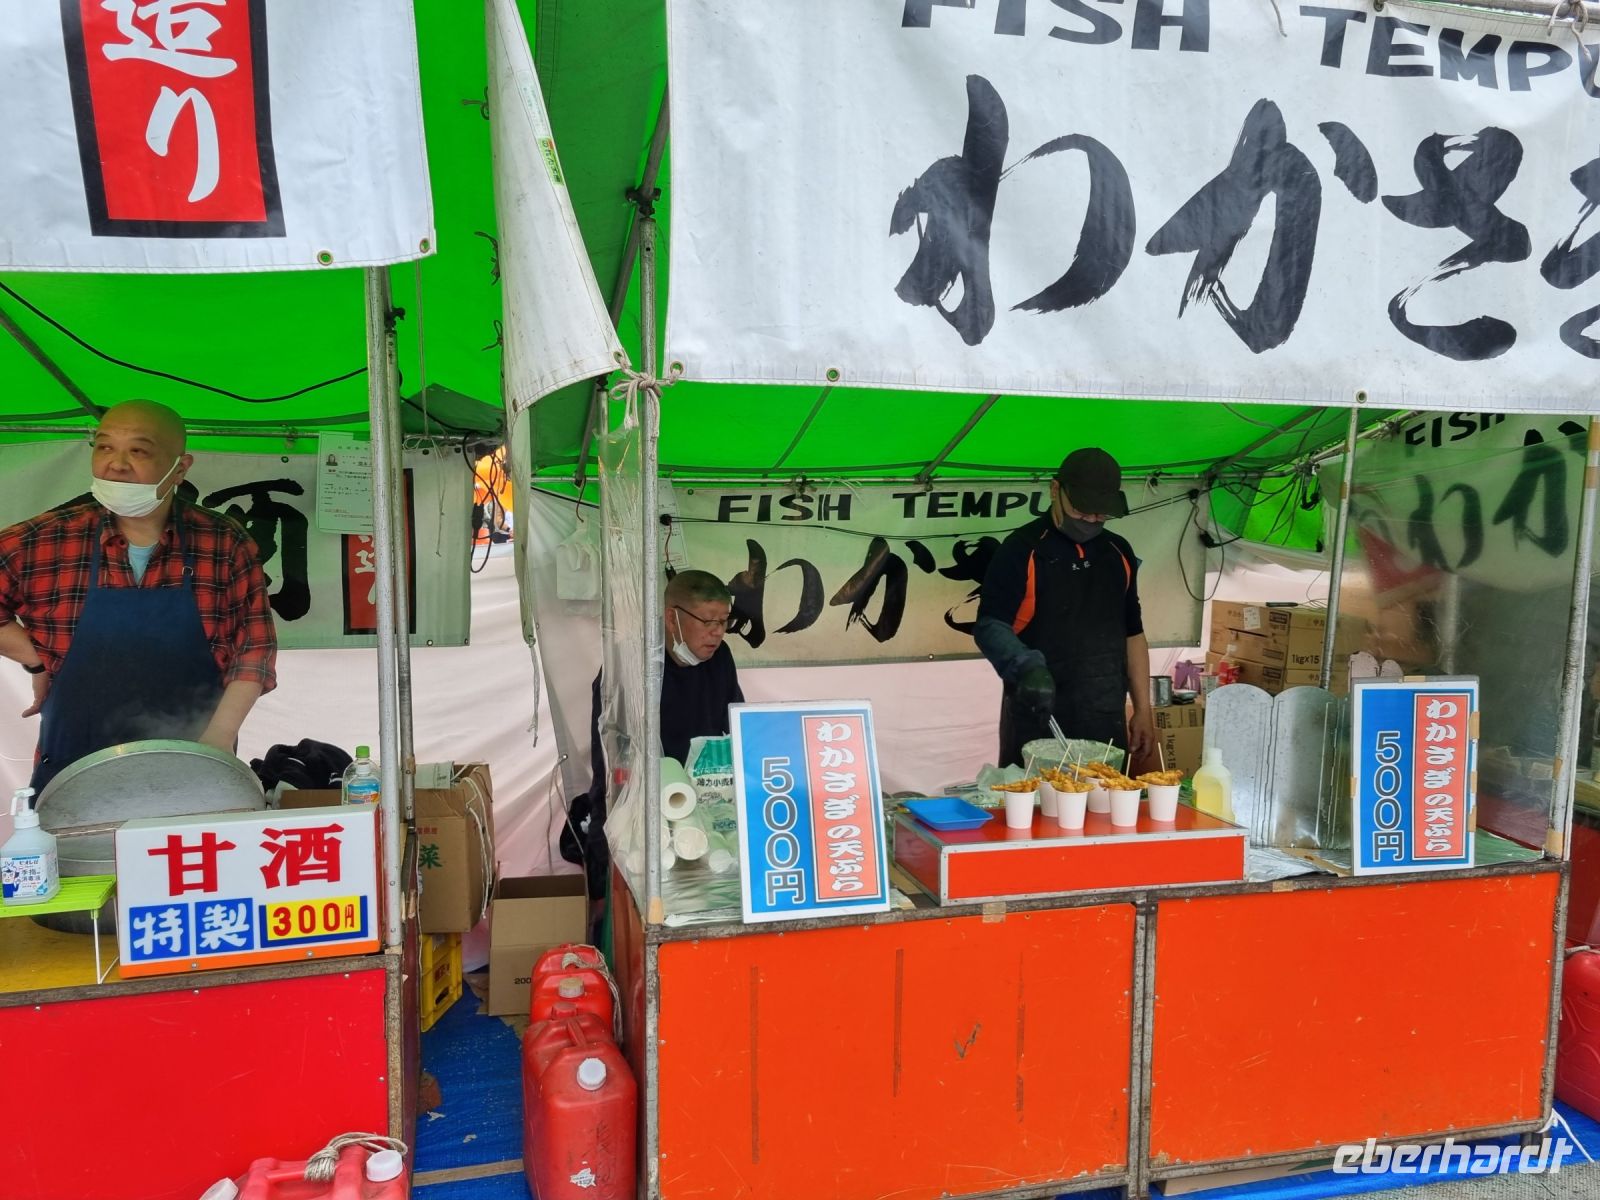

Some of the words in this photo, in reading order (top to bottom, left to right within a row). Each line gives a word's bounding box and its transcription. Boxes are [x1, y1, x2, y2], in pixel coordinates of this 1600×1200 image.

[718, 491, 852, 521] FISH
[761, 756, 806, 906] 500円
[816, 720, 865, 892] わかさぎの天ぷら
[1372, 730, 1405, 862] 500円
[1424, 699, 1458, 852] わかさぎの天ぷら
[147, 823, 345, 897] 甘酒
[133, 903, 250, 956] 特製
[273, 902, 355, 937] 300円
